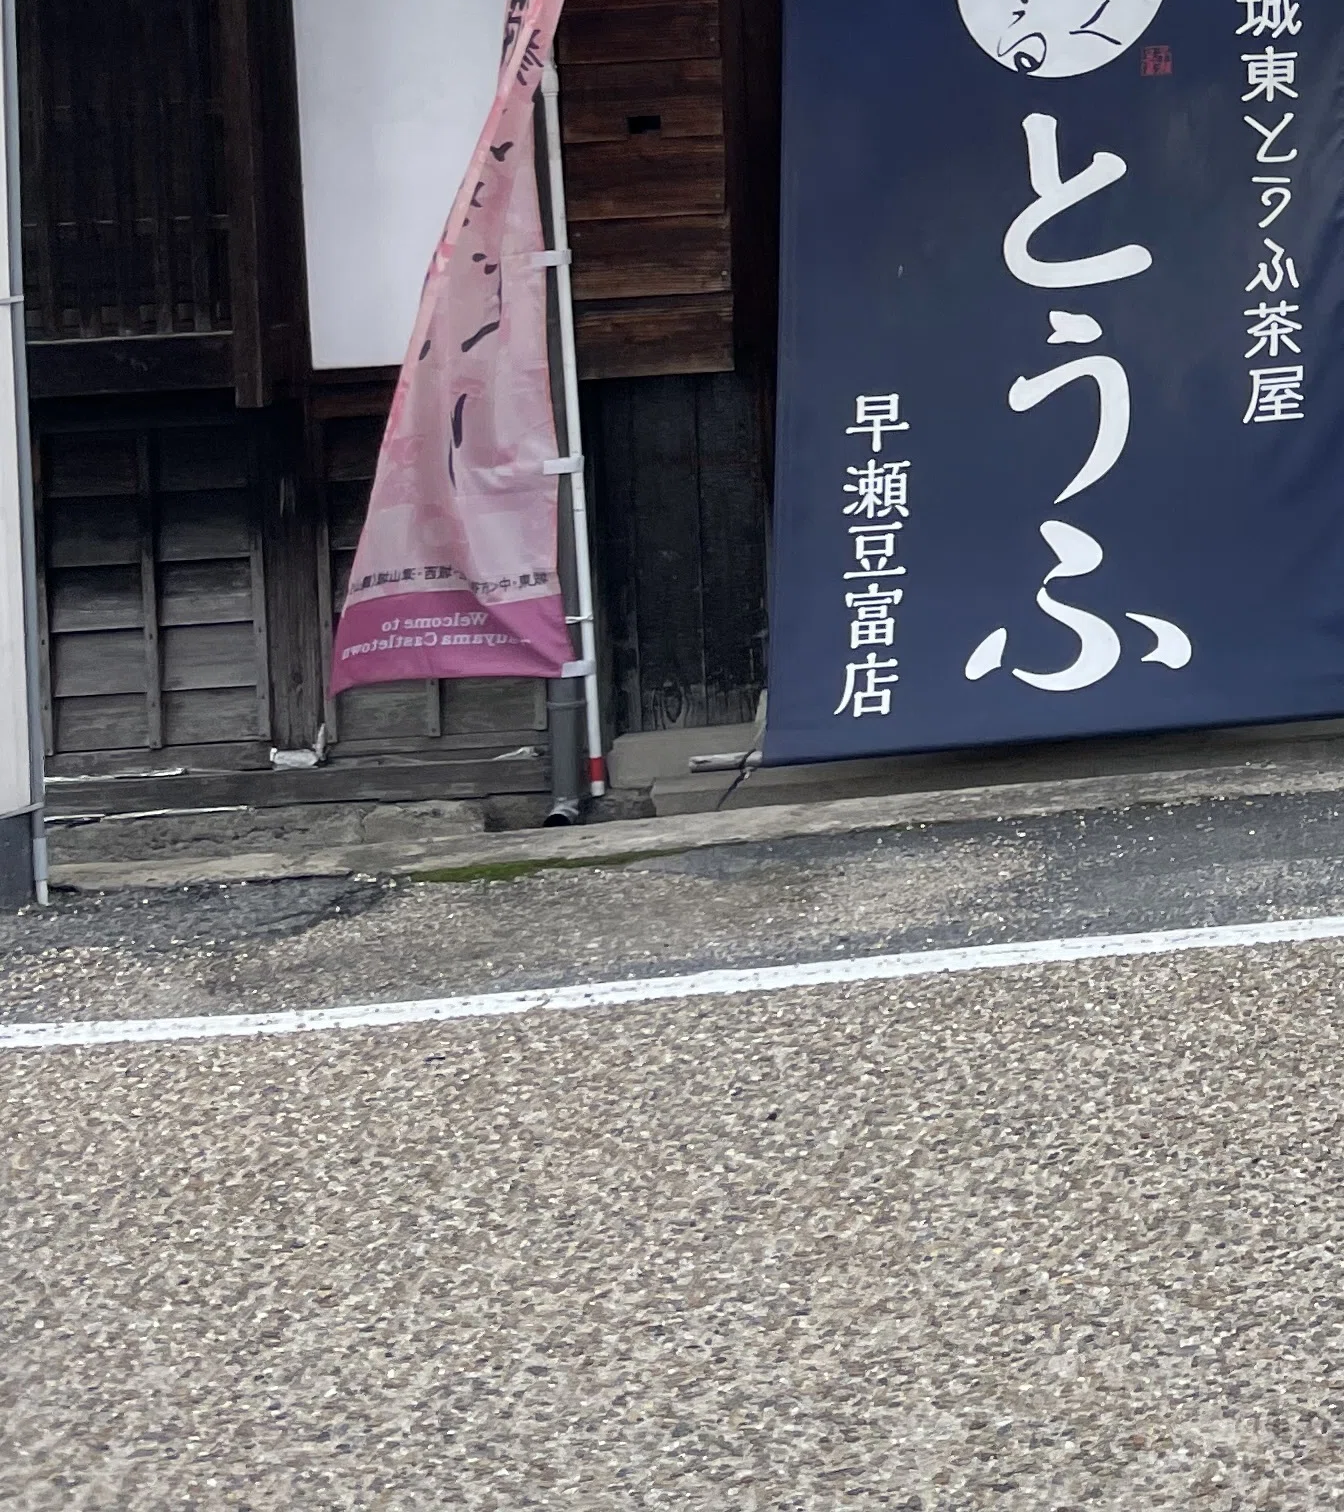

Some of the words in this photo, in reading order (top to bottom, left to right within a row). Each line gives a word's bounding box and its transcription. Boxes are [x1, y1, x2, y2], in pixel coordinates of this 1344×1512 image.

[833, 393, 911, 719] 早瀬豆富店
[964, 112, 1193, 691] とうふ
